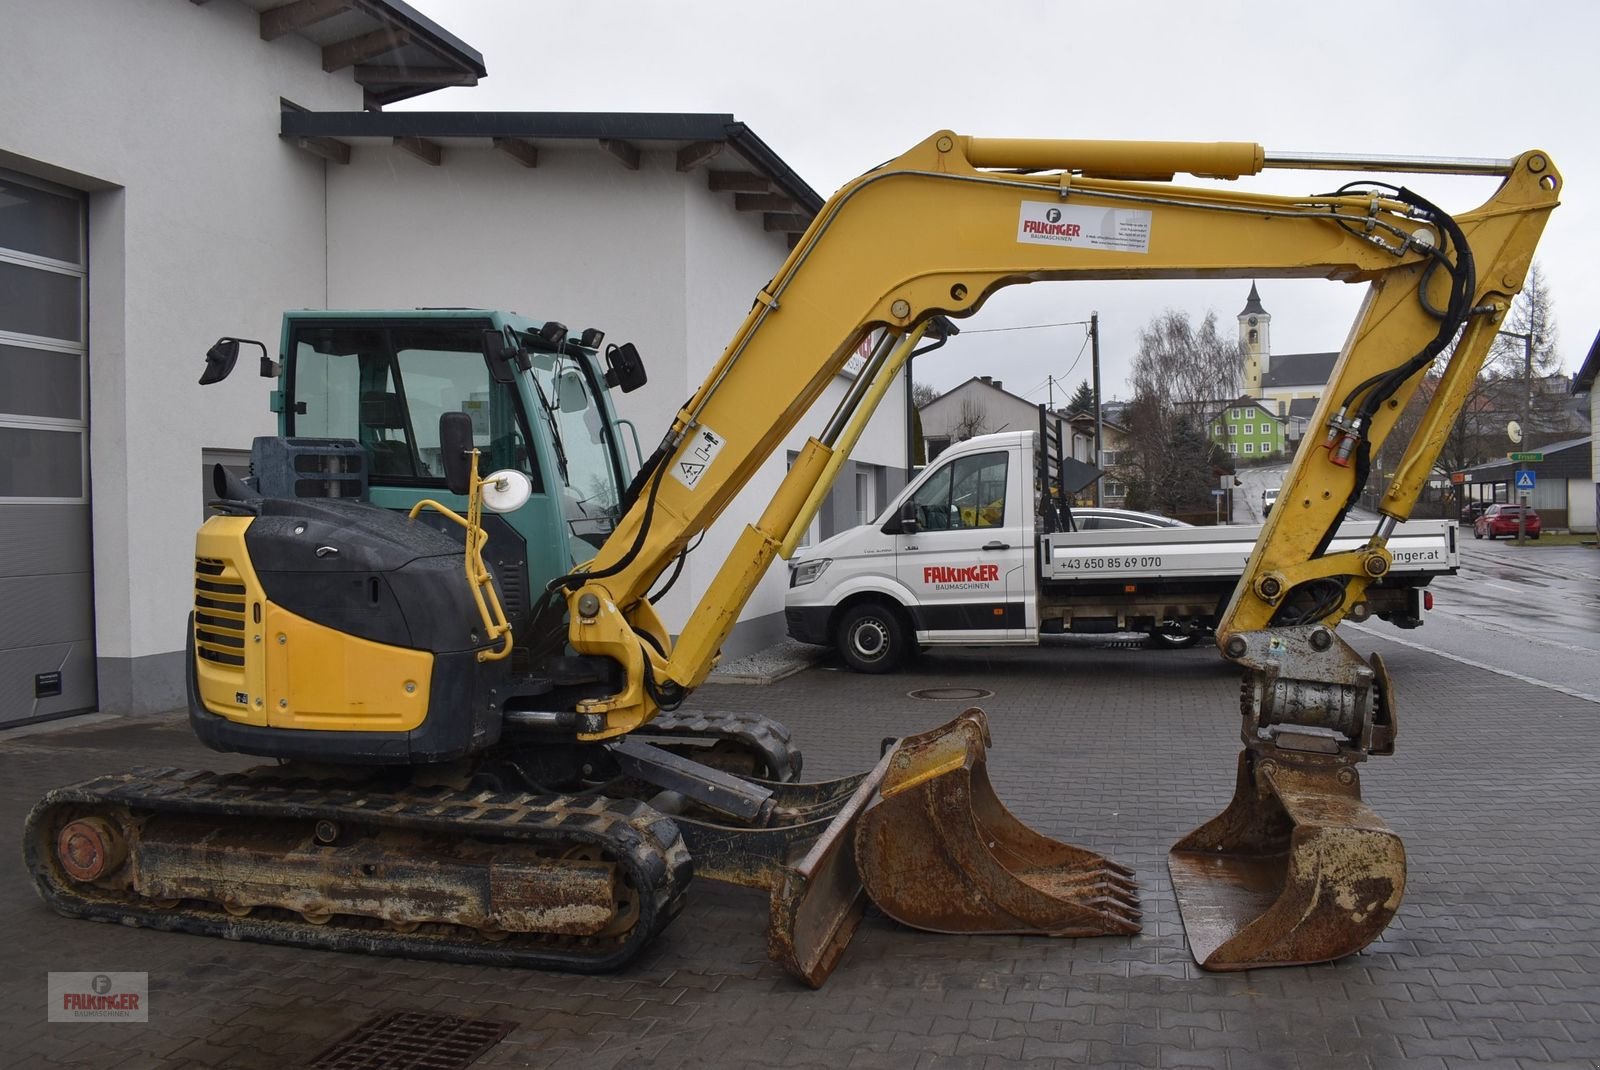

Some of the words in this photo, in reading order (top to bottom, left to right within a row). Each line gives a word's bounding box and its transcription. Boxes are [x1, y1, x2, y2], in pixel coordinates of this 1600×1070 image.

[1023, 220, 1081, 237] FALKINGER
[1030, 234, 1073, 242] BAUMASCHINEN
[1061, 559, 1080, 569] +43
[1084, 558, 1104, 569] 650
[1107, 558, 1121, 568] 85
[1124, 557, 1138, 568] 69
[1141, 556, 1162, 567] 070
[924, 564, 999, 584] FALKINGER
[935, 583, 990, 591] BAUMASCHINEN
